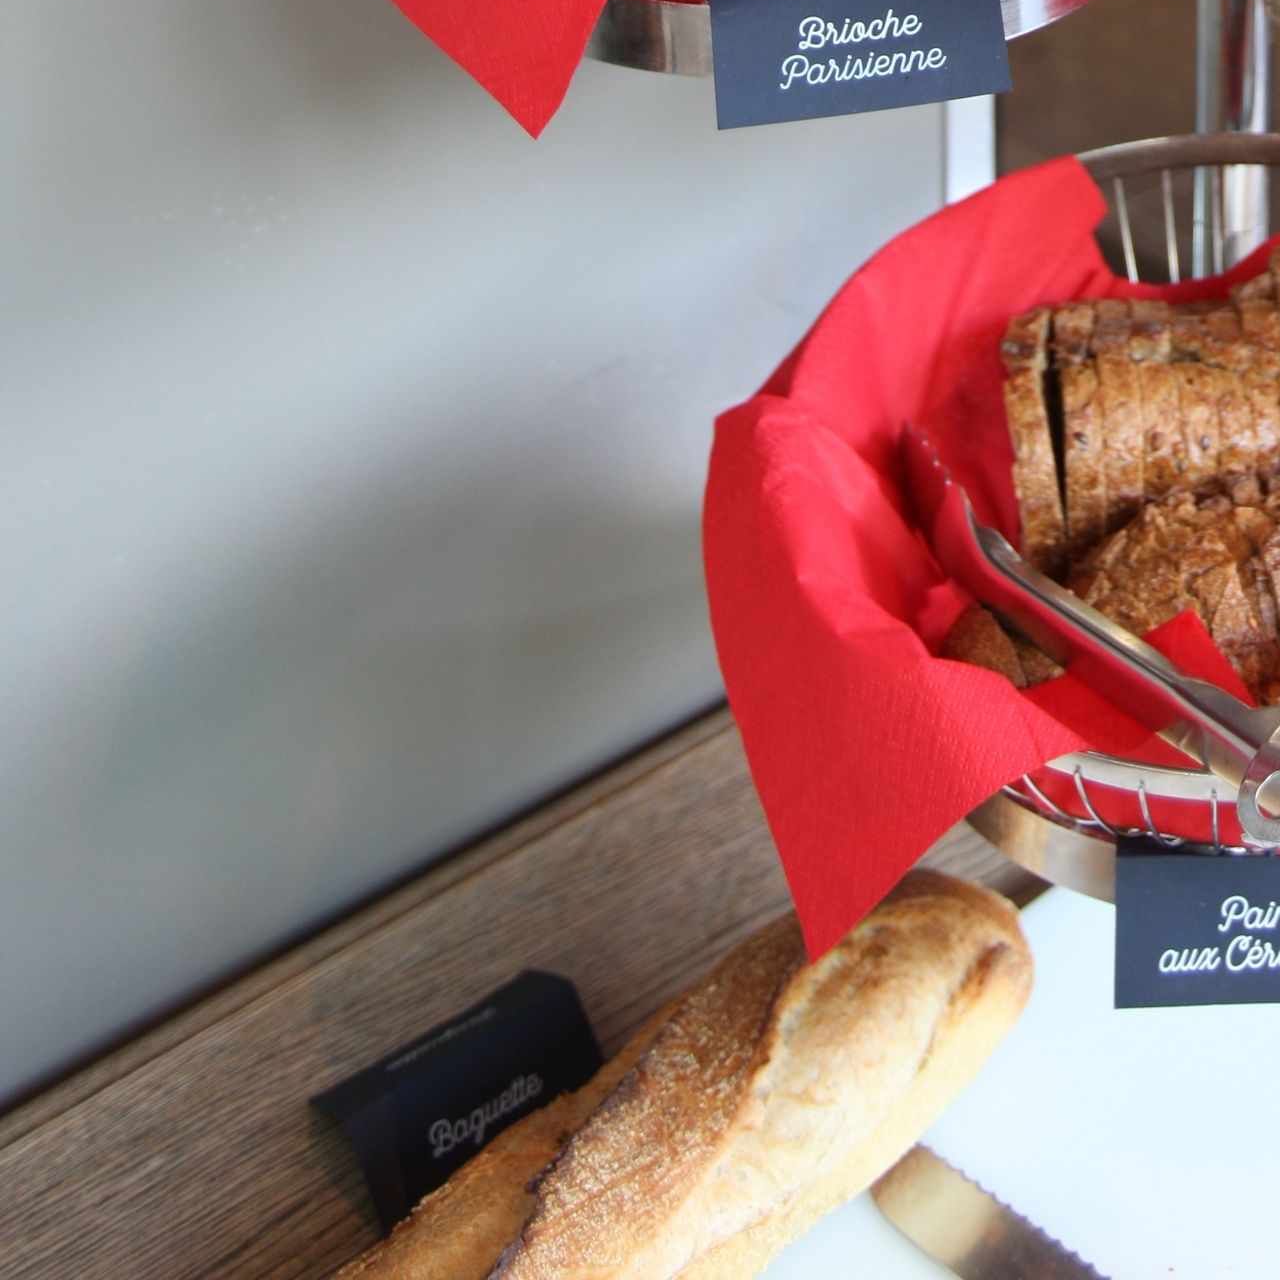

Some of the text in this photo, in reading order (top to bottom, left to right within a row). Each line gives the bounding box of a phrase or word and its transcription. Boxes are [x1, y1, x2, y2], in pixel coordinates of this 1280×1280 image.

[798, 9, 923, 51] Brioche
[779, 47, 948, 91] Parisienne
[1158, 945, 1221, 972] aux
[428, 1073, 543, 1158] Baguette
